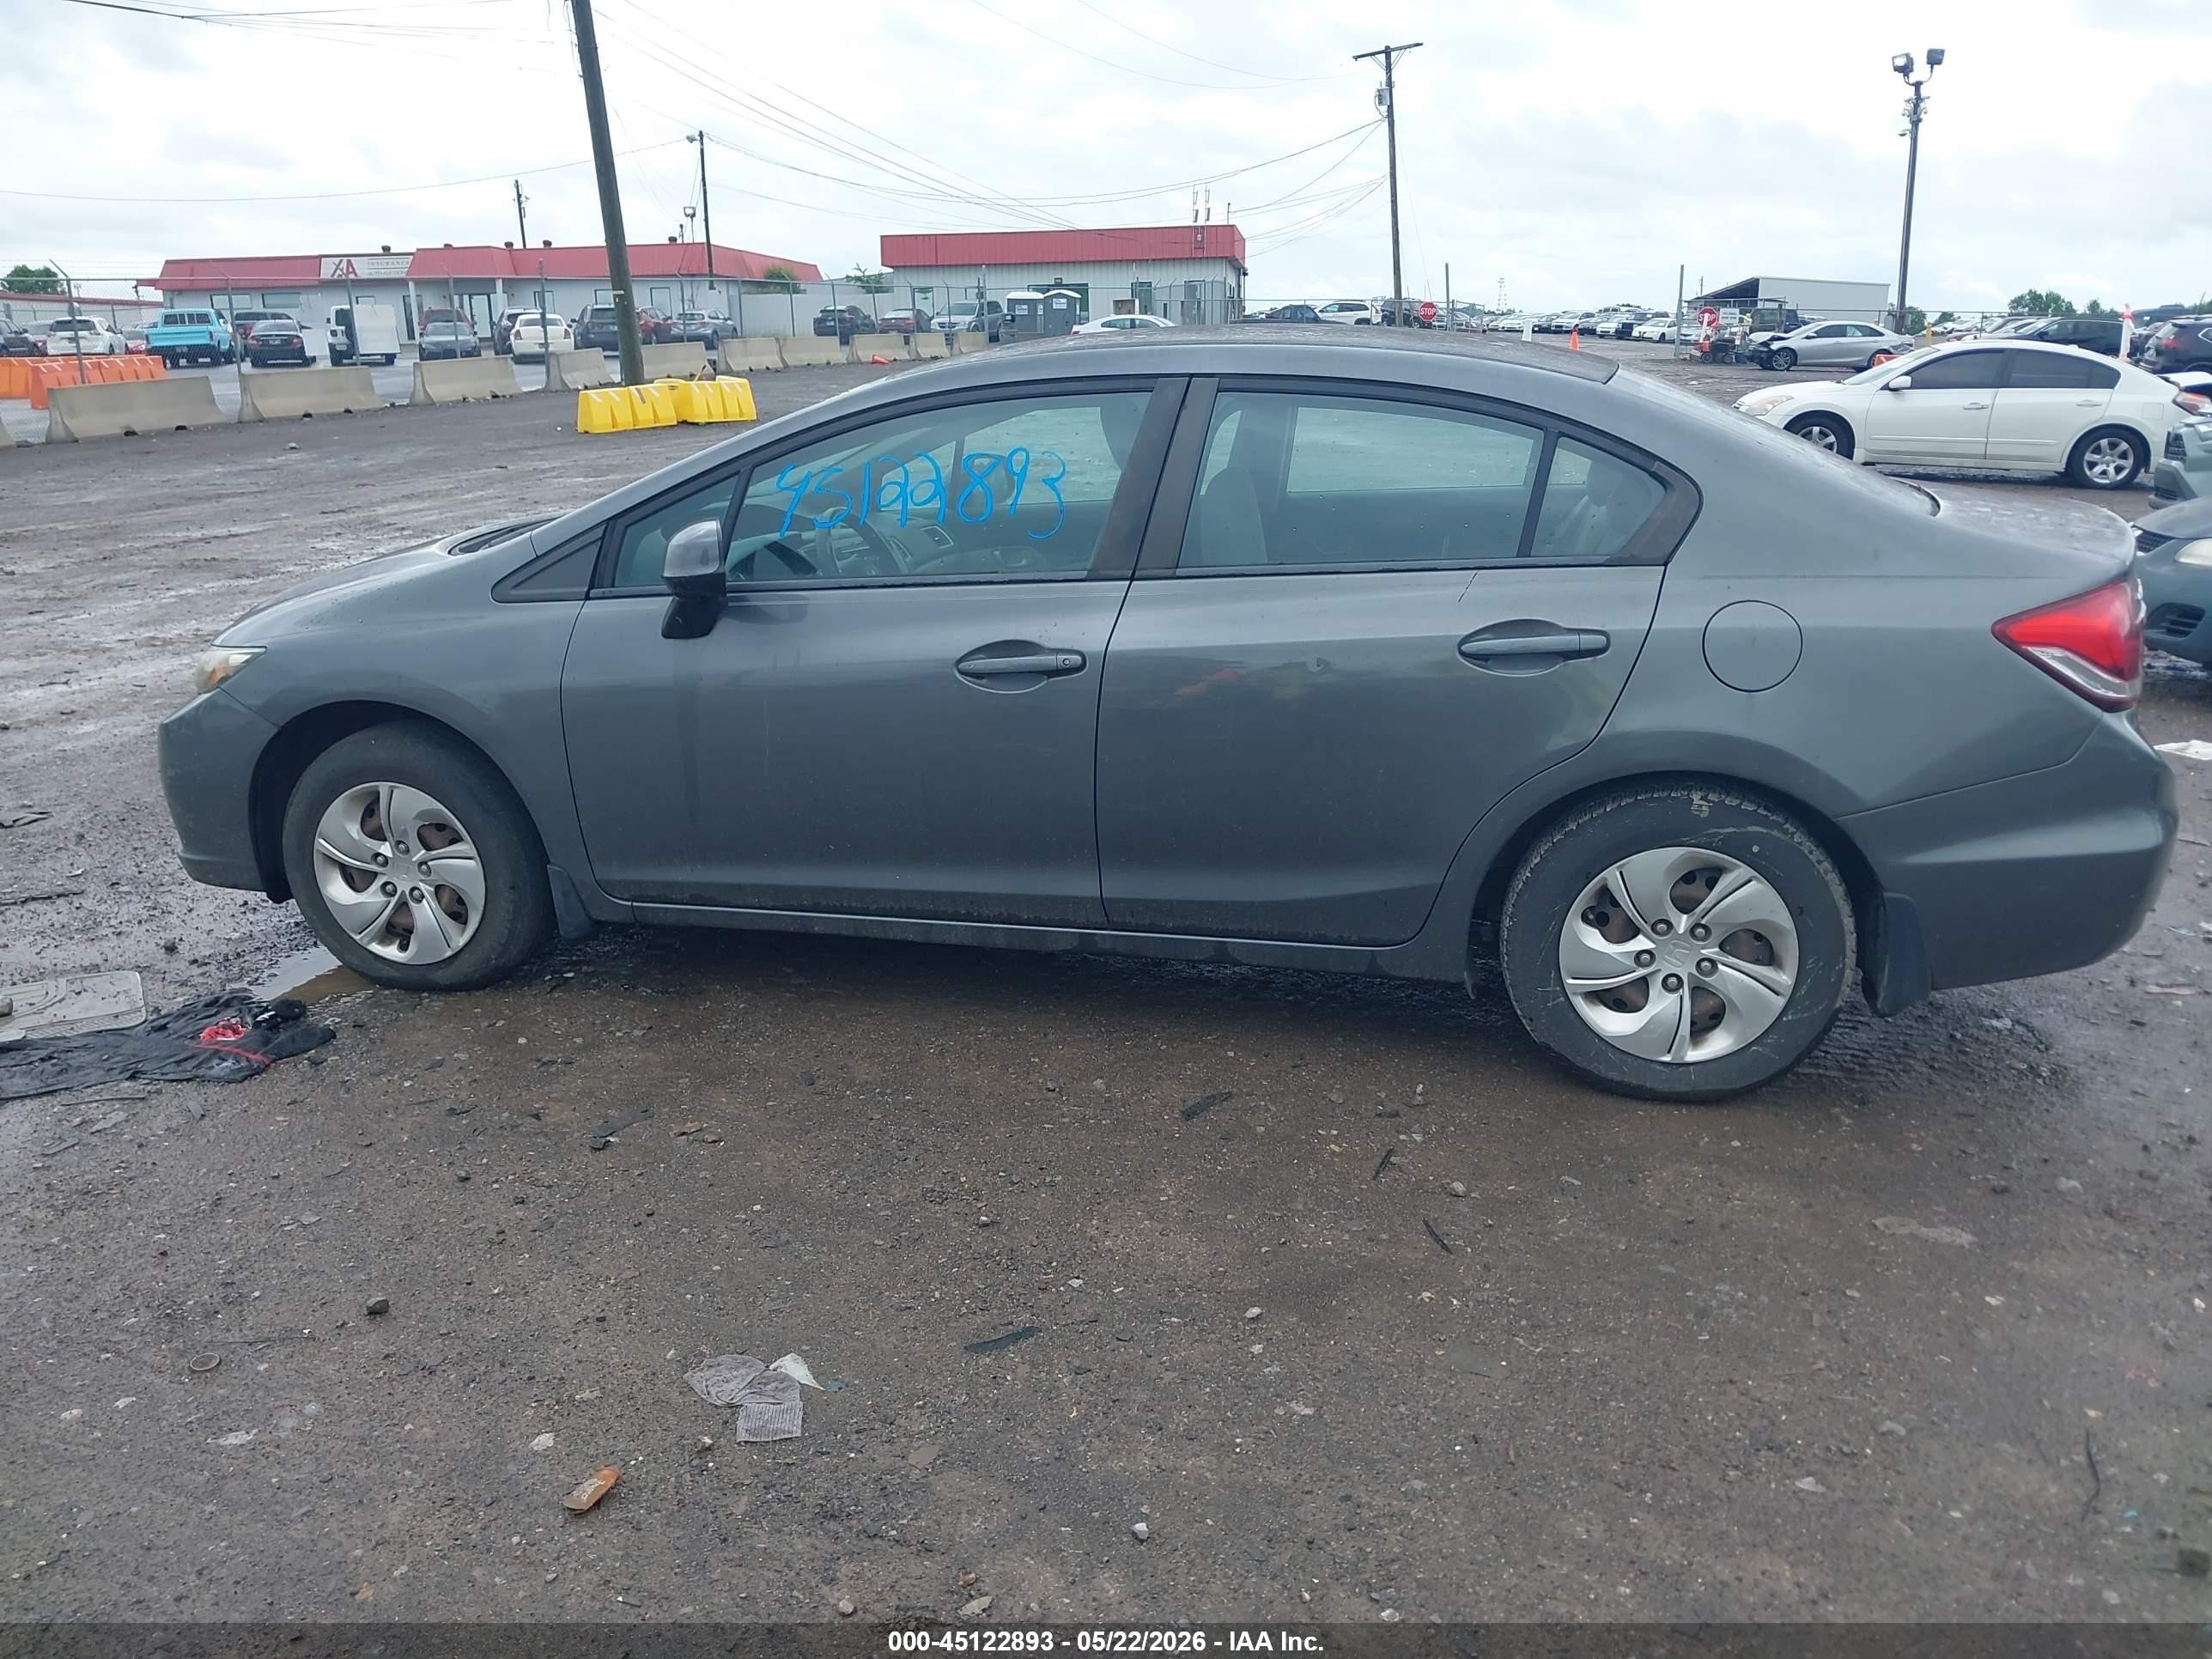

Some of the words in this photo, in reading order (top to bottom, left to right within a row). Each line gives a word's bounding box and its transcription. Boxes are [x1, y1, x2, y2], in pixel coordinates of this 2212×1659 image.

[1420, 307, 1437, 315] STOP
[1698, 313, 1717, 322] SOP
[776, 447, 1066, 540] 45122893
